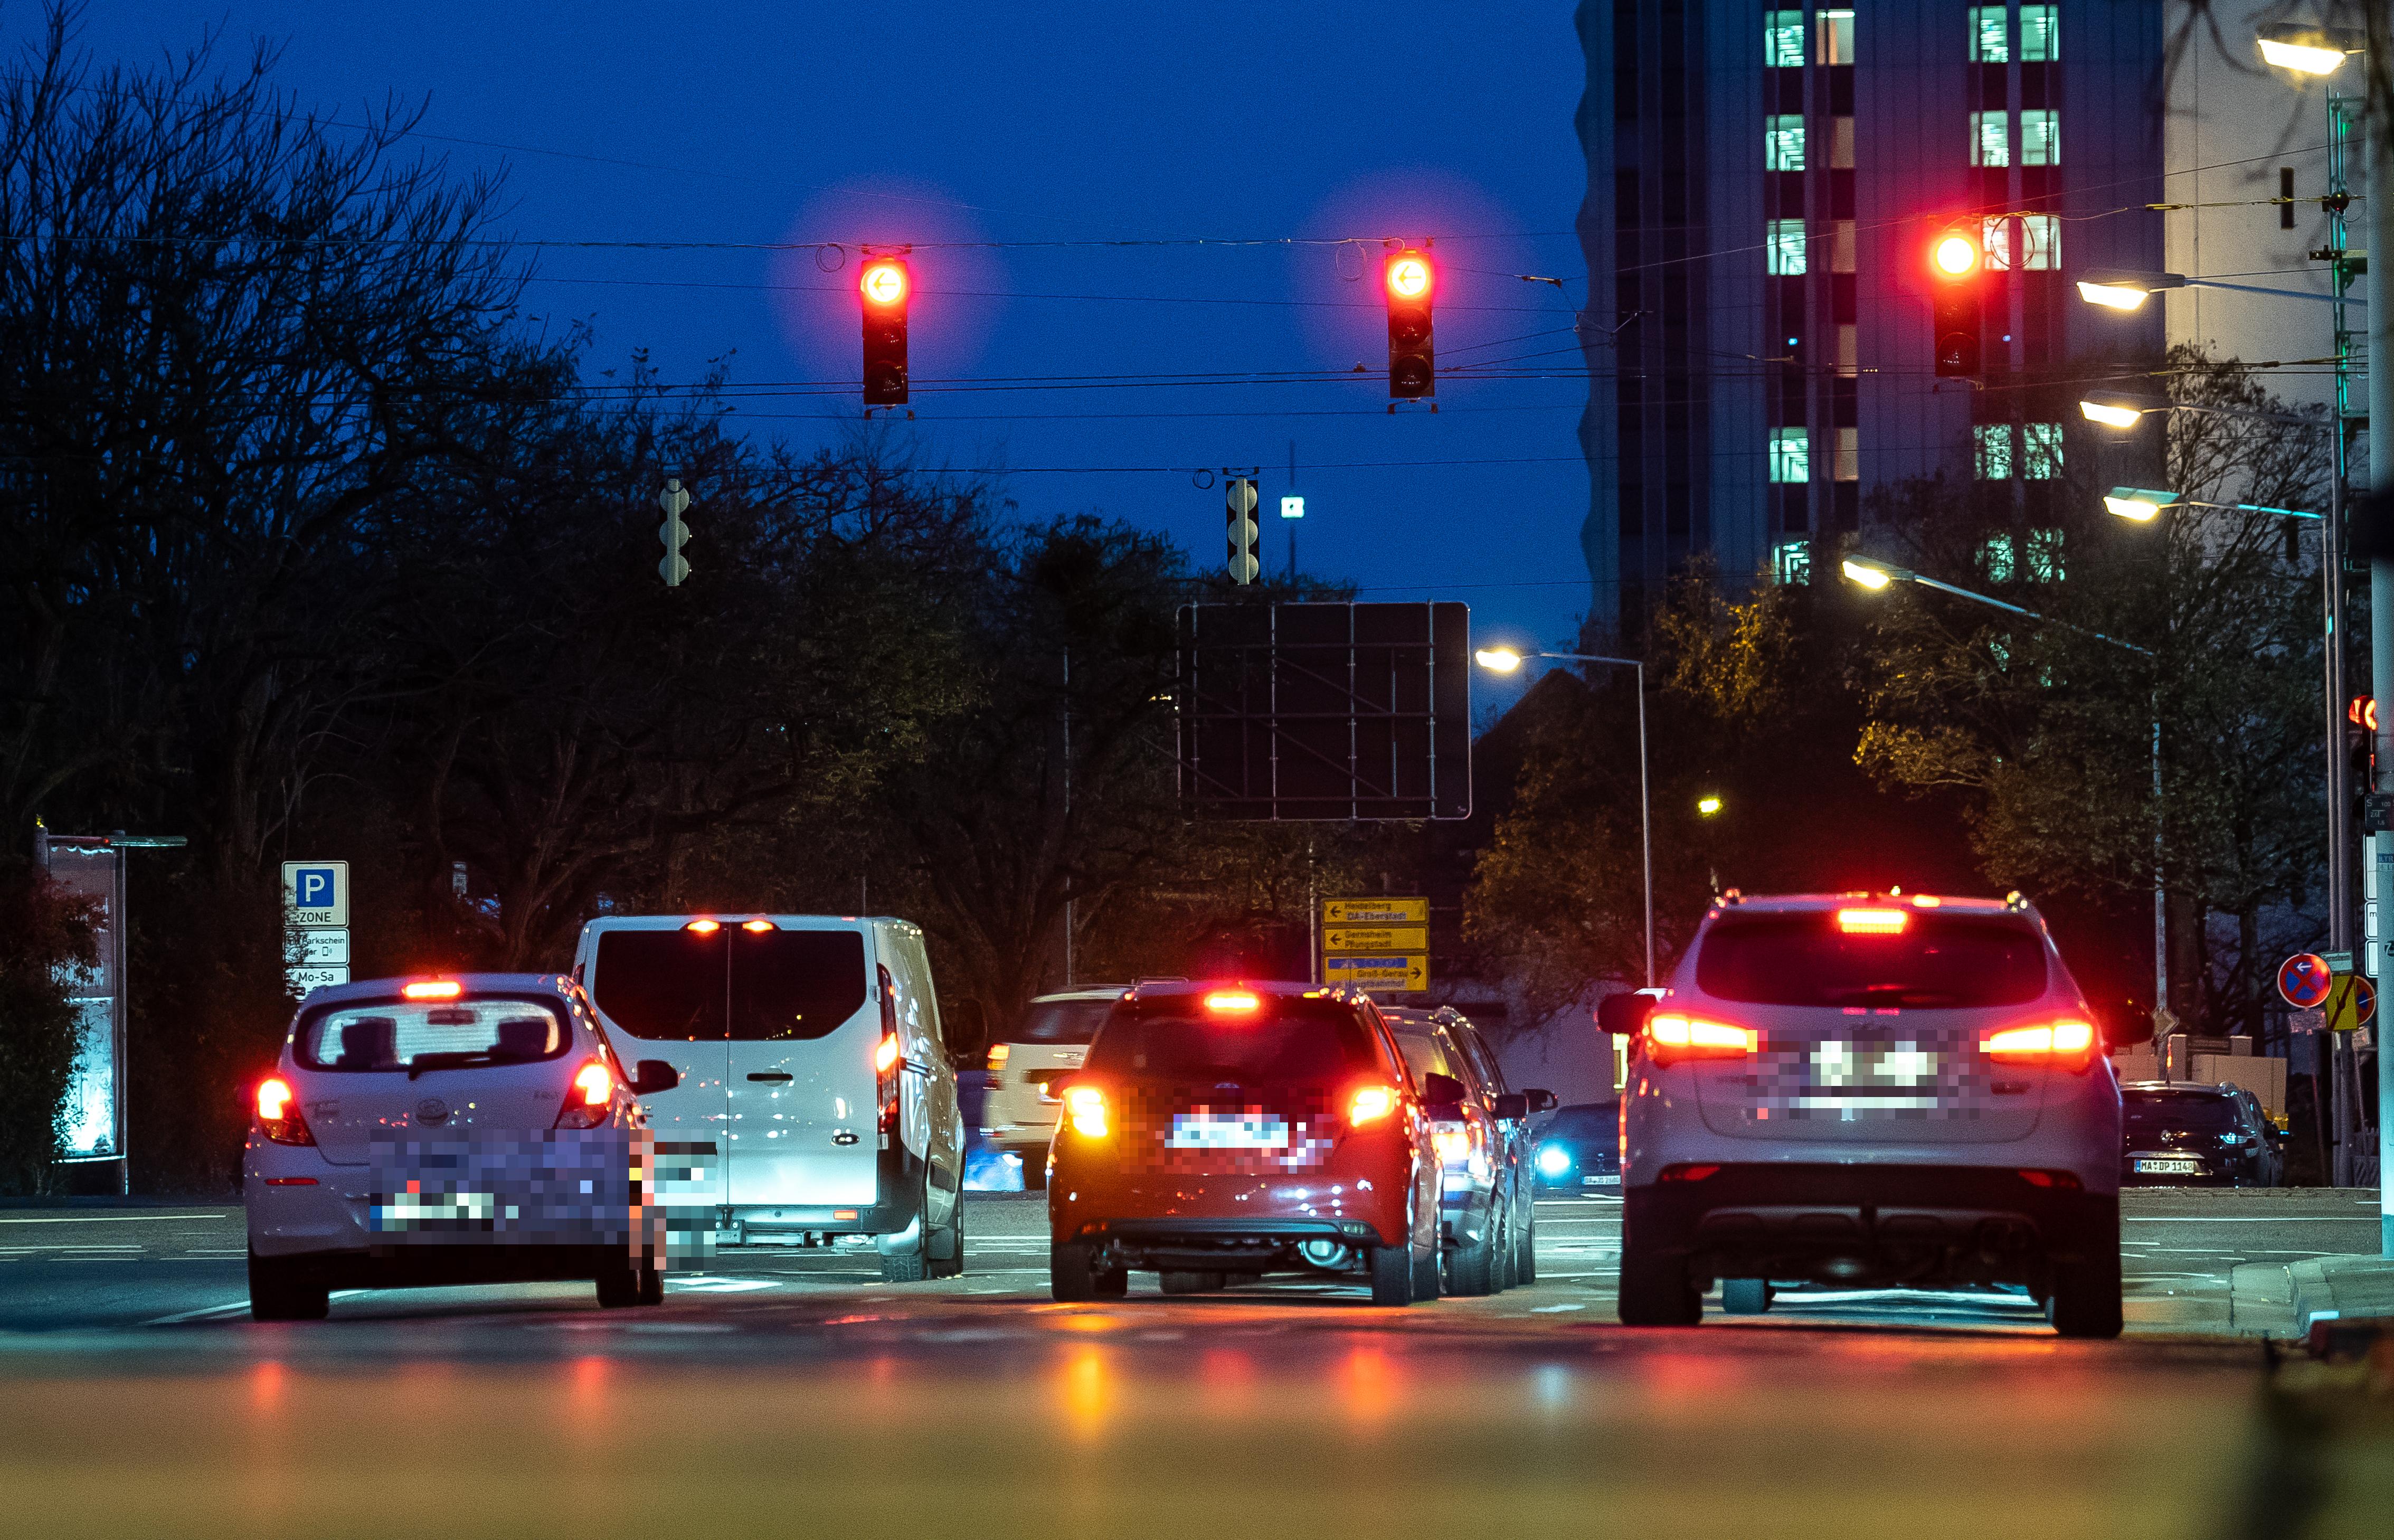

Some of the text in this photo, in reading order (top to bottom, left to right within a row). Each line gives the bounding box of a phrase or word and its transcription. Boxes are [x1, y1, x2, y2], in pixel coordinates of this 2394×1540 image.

[306, 874, 325, 902] P
[299, 912, 331, 922] ZONE
[298, 971, 334, 981] Mo-Sa
[2141, 1161, 2152, 1170] MA
[2159, 1162, 2170, 1170] DP
